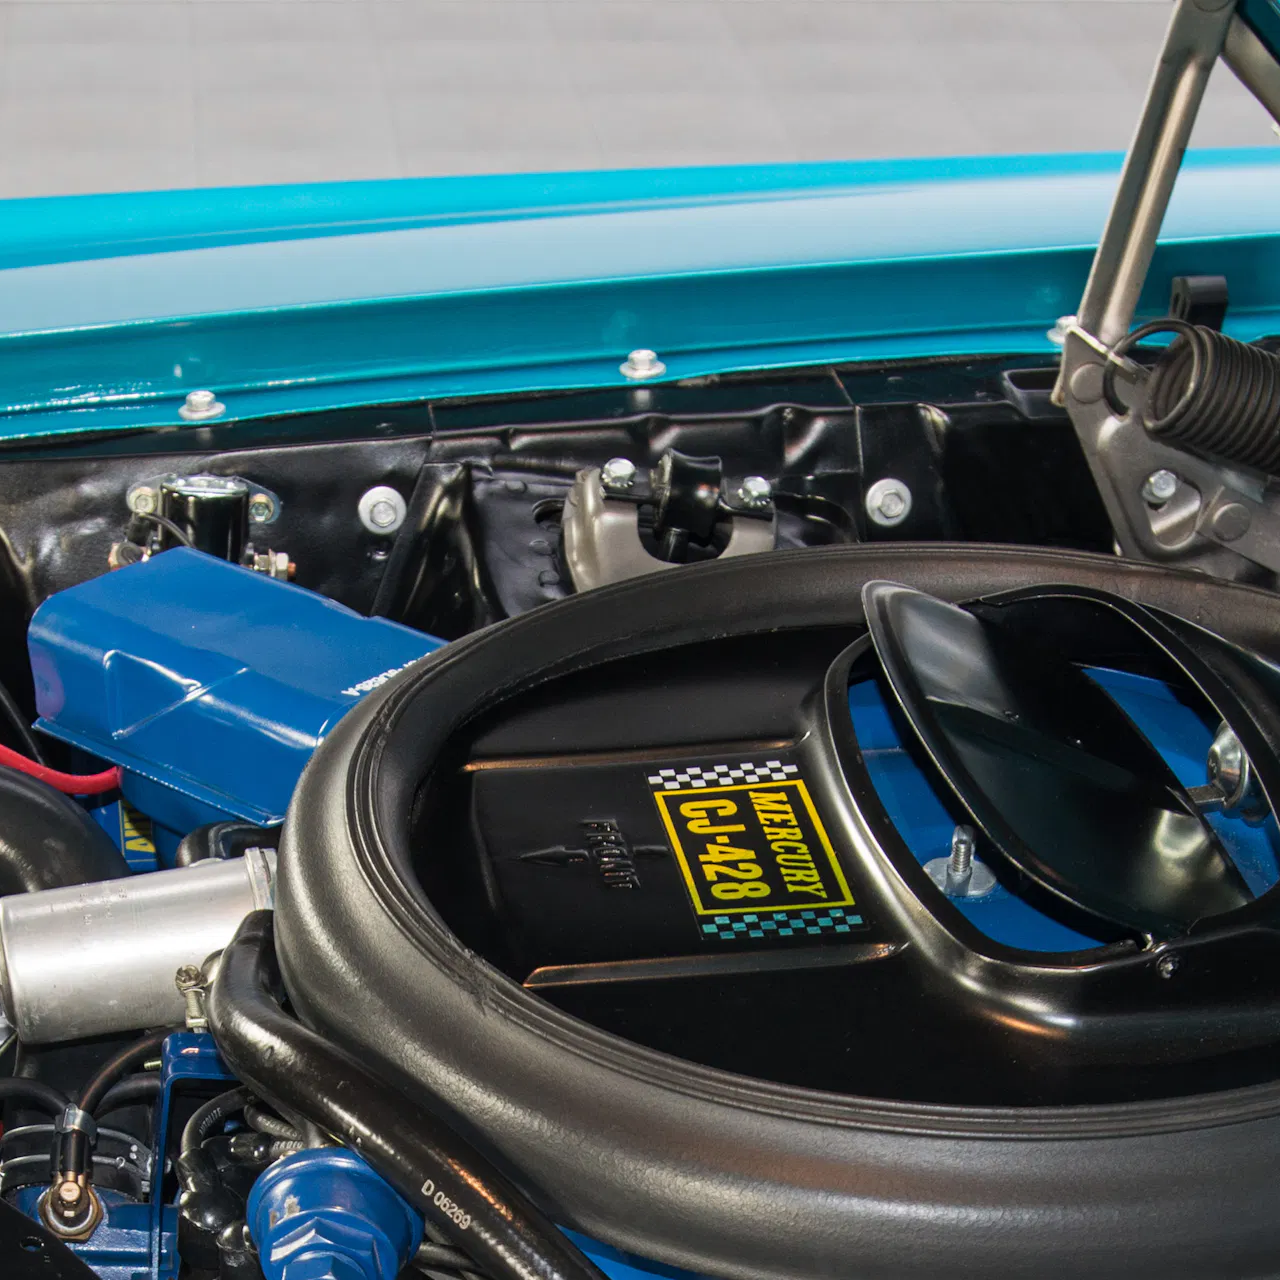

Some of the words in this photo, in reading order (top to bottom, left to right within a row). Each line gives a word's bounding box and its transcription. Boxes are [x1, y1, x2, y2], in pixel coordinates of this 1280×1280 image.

[748, 790, 827, 899] MERCURY
[421, 1179, 435, 1196] D
[433, 1191, 473, 1230] 06269
